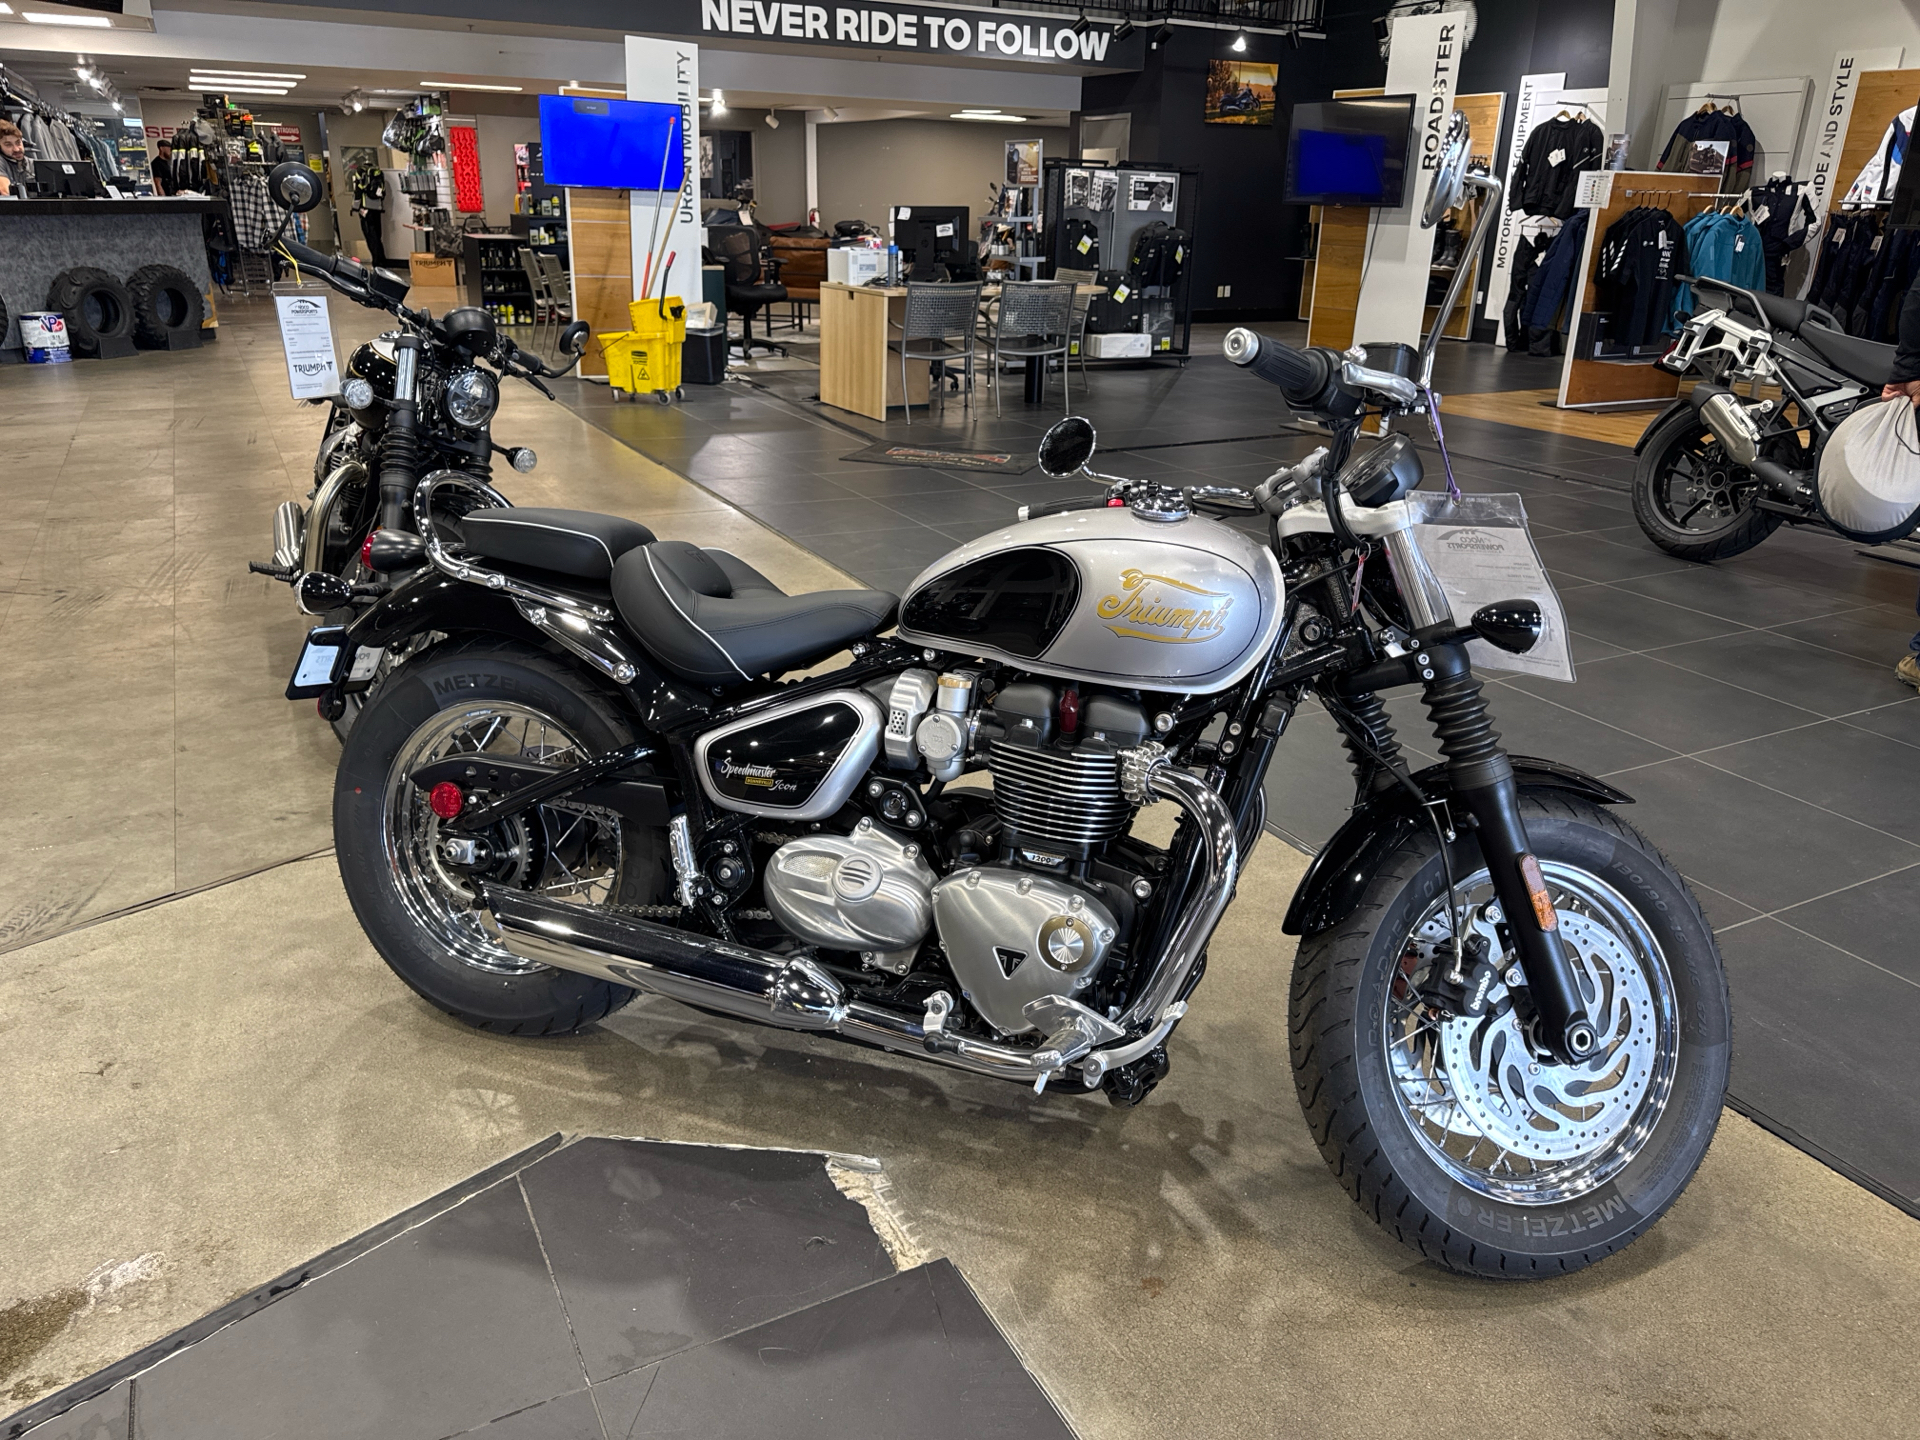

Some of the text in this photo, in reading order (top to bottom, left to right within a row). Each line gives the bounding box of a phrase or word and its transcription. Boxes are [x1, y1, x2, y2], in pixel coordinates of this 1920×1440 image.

[701, 0, 1111, 62] NEVER RIDE TO FOLLOW
[677, 50, 692, 150] MOBILITY
[1421, 23, 1455, 170] ROADSTER
[1829, 57, 1855, 116] STYLE
[1512, 81, 1534, 169] EQUIPMENT
[1820, 120, 1839, 158] AND
[40, 314, 57, 333] VP
[293, 362, 327, 374] TRIUMPH
[1096, 568, 1235, 643] Triumph
[432, 673, 561, 713] METZELER
[720, 756, 777, 779] Speedmaster
[768, 779, 797, 791] Icon
[1032, 854, 1051, 863] 1200
[1470, 970, 1492, 1011] brembo
[1477, 1194, 1628, 1238] METZELER
